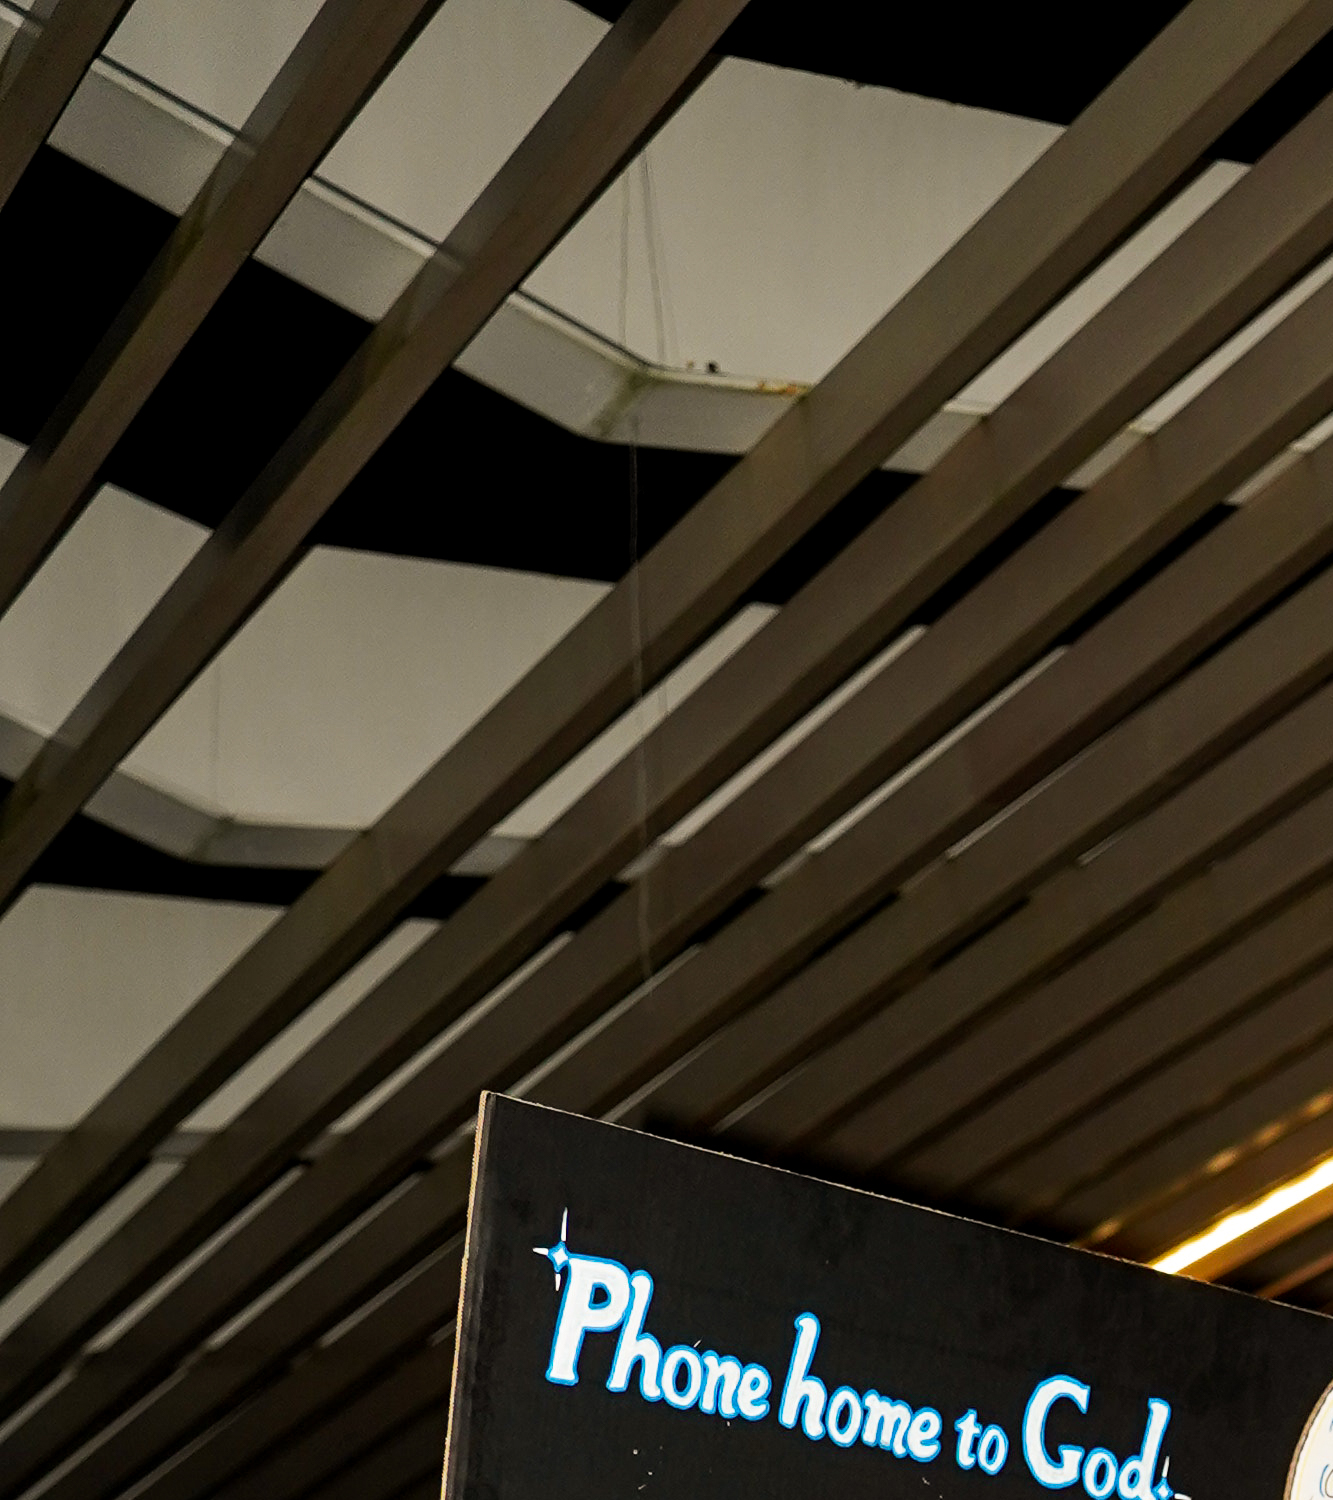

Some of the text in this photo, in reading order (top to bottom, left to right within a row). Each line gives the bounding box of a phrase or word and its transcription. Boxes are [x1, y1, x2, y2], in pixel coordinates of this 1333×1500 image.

[546, 1252, 771, 1420] Phone
[779, 1312, 941, 1468] home
[956, 1407, 1007, 1475] to
